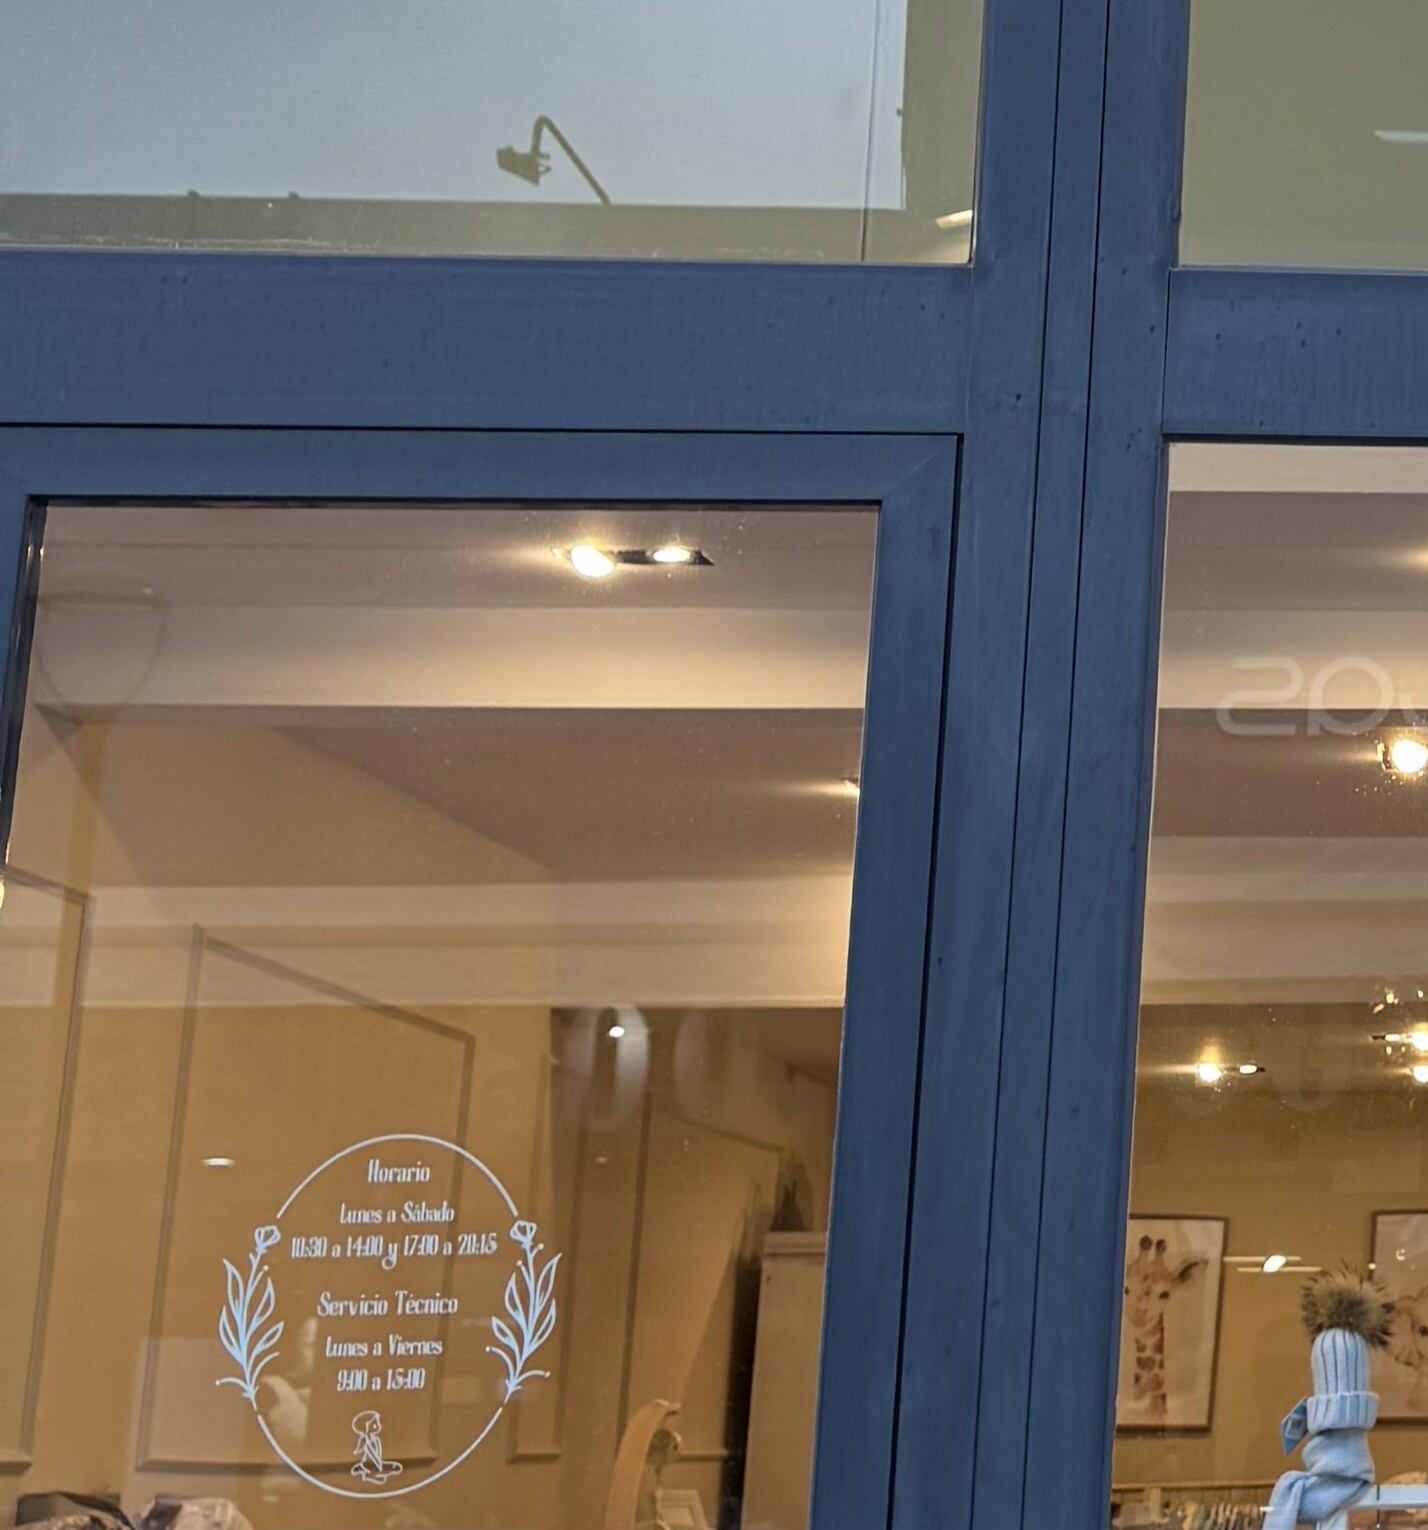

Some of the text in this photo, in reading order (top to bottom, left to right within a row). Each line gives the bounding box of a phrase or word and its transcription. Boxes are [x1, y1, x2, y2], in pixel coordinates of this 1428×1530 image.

[367, 1159, 431, 1183] Horario
[339, 1200, 455, 1225] Lunes a Sábado
[291, 1233, 498, 1270] 10:30 a 14:00 y 17:00 a 20:15
[317, 1289, 459, 1316] Servicio Técnico
[325, 1333, 443, 1358] Lunes a Viernes
[337, 1367, 426, 1392] 9:00 a 15:00
